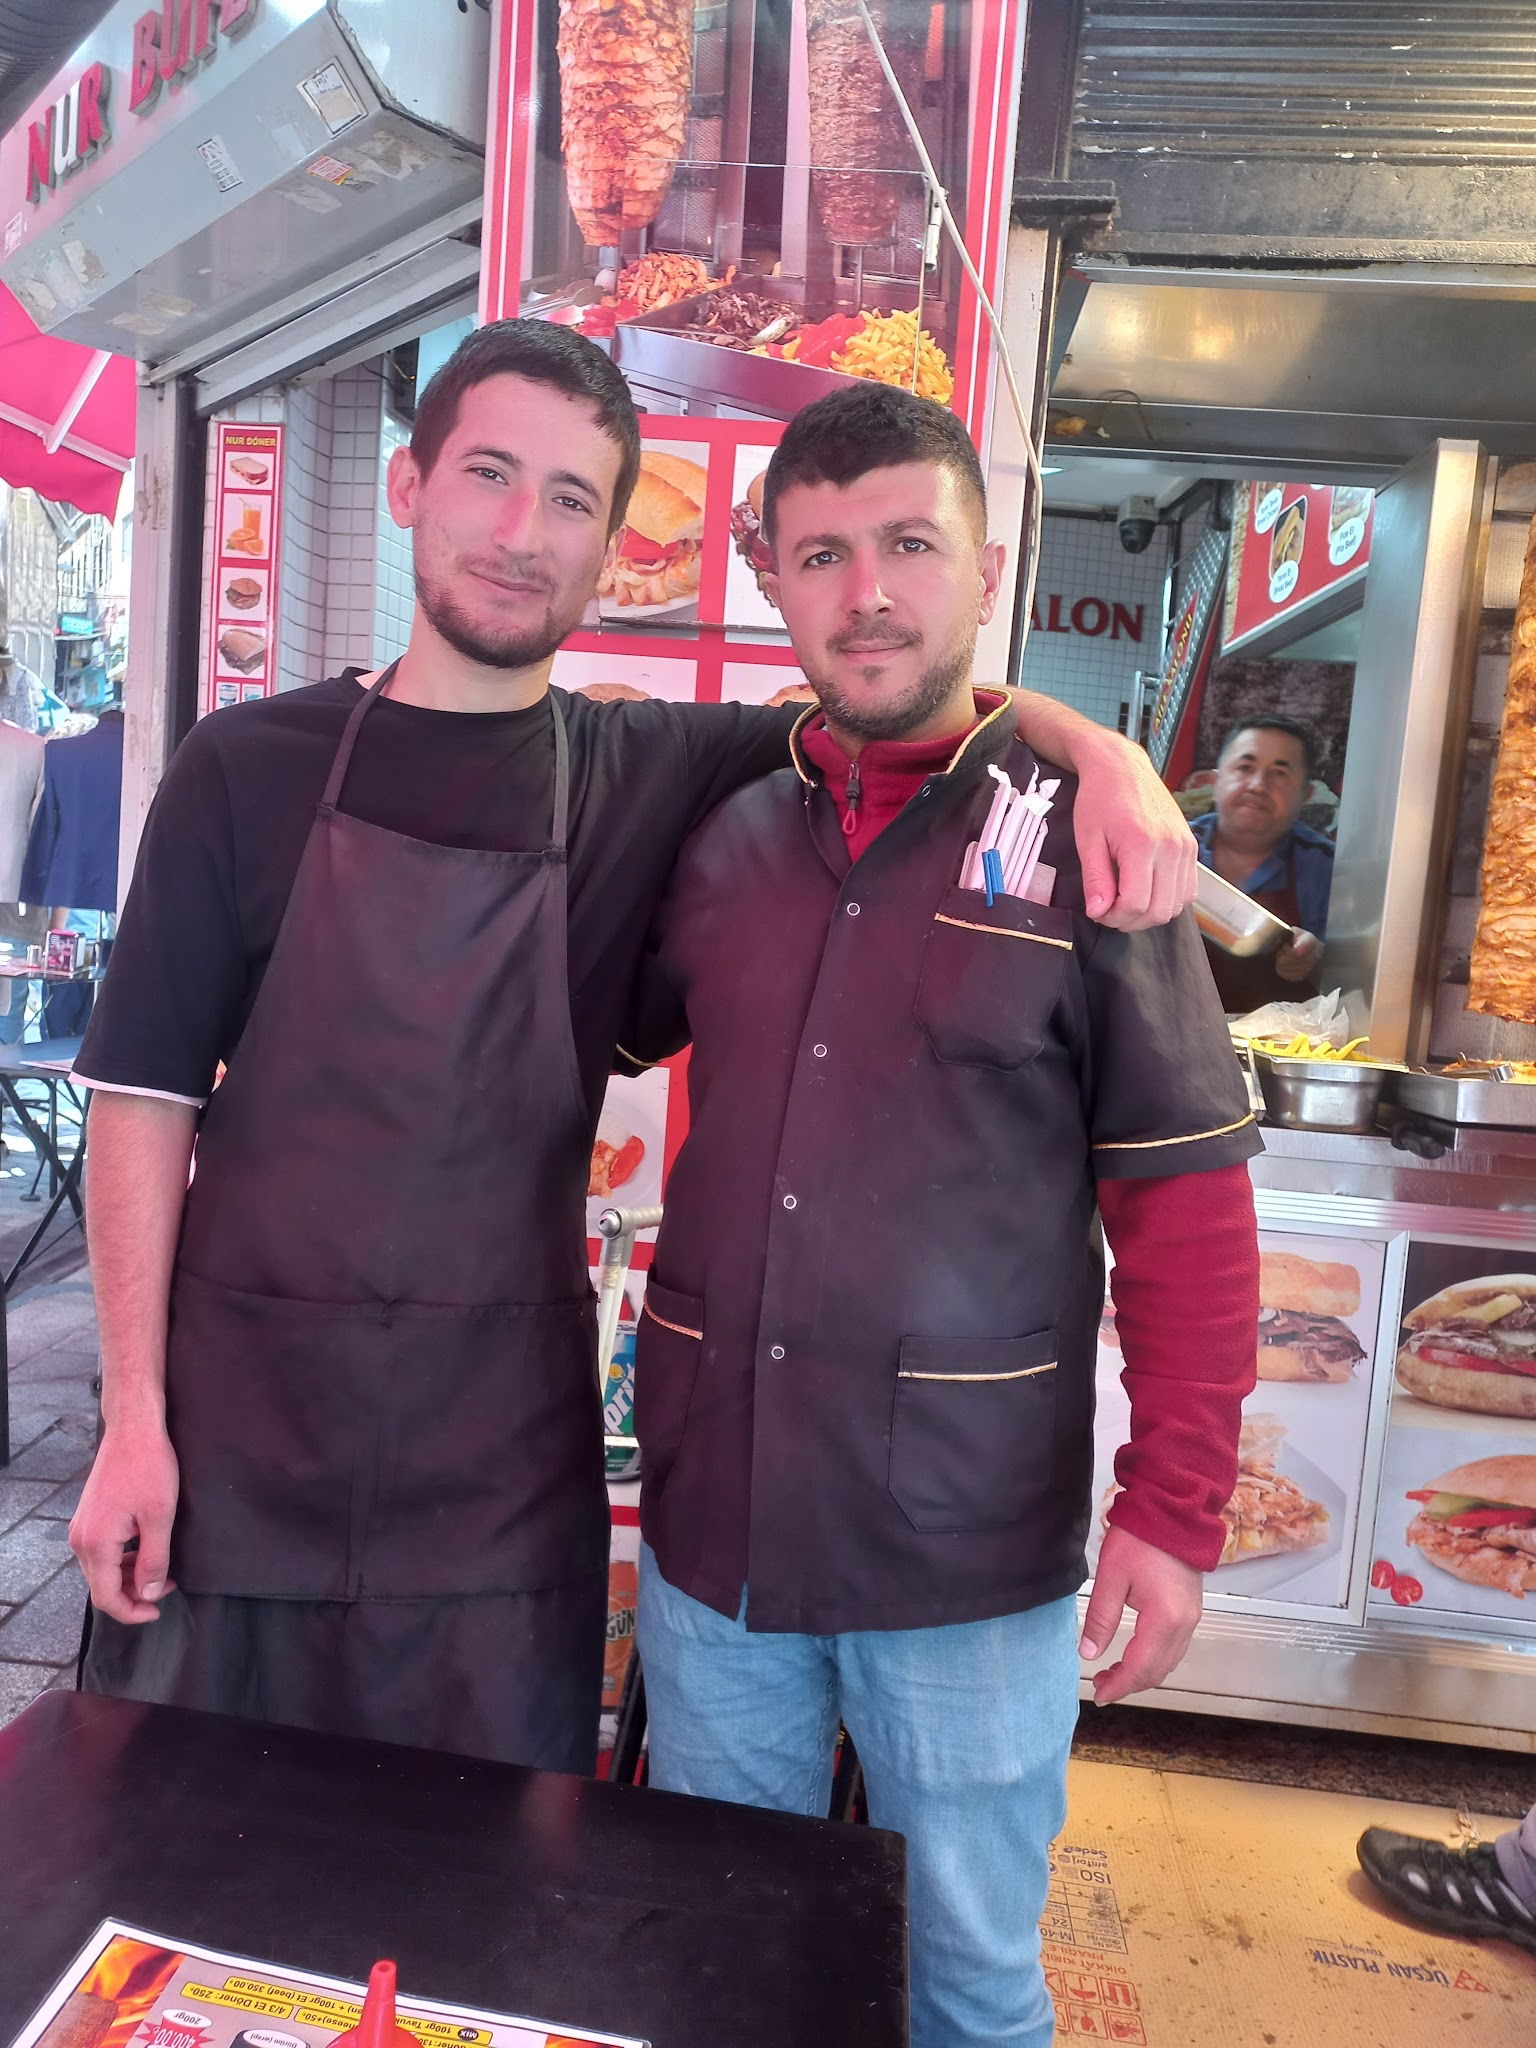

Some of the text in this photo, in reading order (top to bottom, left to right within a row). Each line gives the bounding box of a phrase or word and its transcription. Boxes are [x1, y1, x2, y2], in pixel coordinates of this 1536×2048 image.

[26, 61, 108, 202] NUR
[1080, 1869, 1111, 1885] ISO
[267, 1988, 296, 2000] (beef)
[296, 1994, 308, 2003] Et
[254, 2001, 267, 2010] Et
[308, 1997, 336, 2009] 100gr
[269, 2004, 286, 2015] 4/3
[173, 2011, 202, 2025] 200gr
[425, 2022, 452, 2034] 100gr
[459, 2029, 478, 2039] MIX
